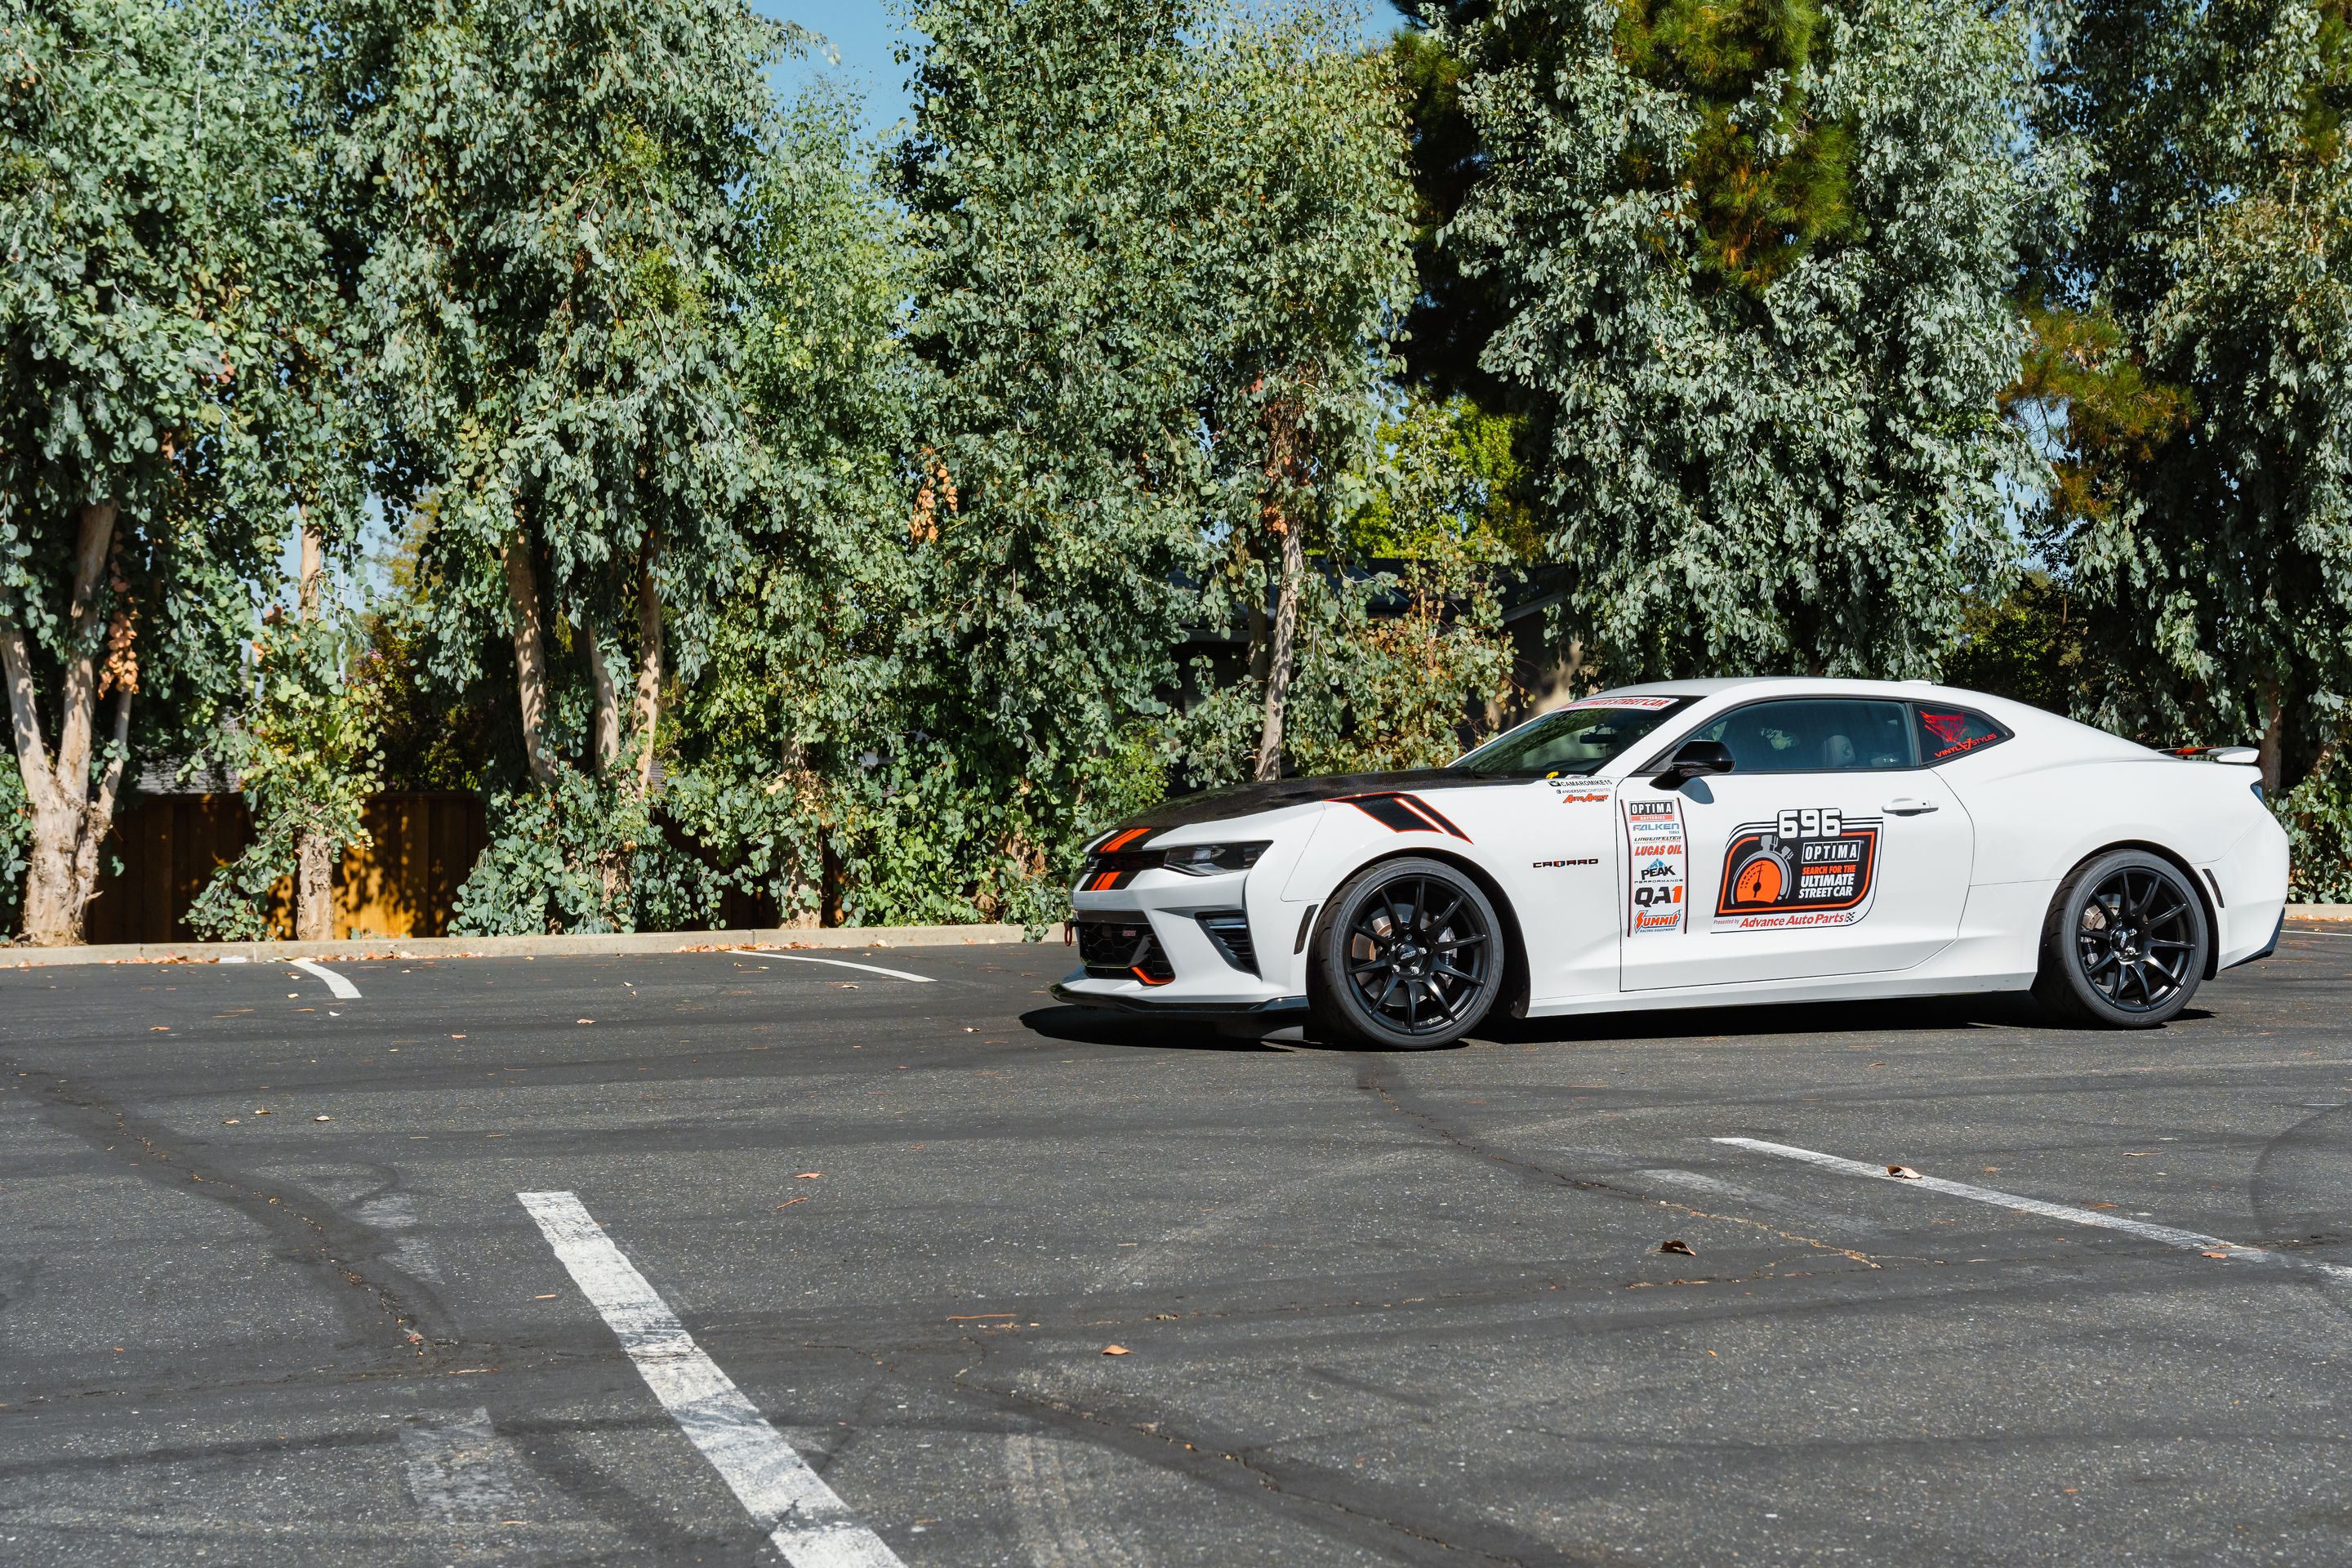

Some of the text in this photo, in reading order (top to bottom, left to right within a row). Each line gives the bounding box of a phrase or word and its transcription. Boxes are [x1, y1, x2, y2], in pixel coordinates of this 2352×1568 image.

[1642, 698, 1670, 707] CAR
[1935, 745, 1961, 757] VINYL
[1971, 733, 1997, 745] STYLES
[1632, 803, 1672, 814] OPTIMA
[1633, 823, 1679, 831] FALKEN
[1779, 808, 1841, 839] 696
[1635, 844, 1682, 856] LUCAS OIL
[1805, 844, 1856, 860] OPTIMA
[1641, 866, 1676, 880] PEAK
[1802, 865, 1855, 875] SEARCH FOR THE
[1801, 874, 1855, 887] ULTIMATE
[1634, 886, 1682, 907] QA1
[1799, 886, 1853, 898] STREET CAR
[1740, 917, 1785, 929] Advance
[1785, 915, 1815, 925] Auto
[1815, 913, 1845, 924] Parts
